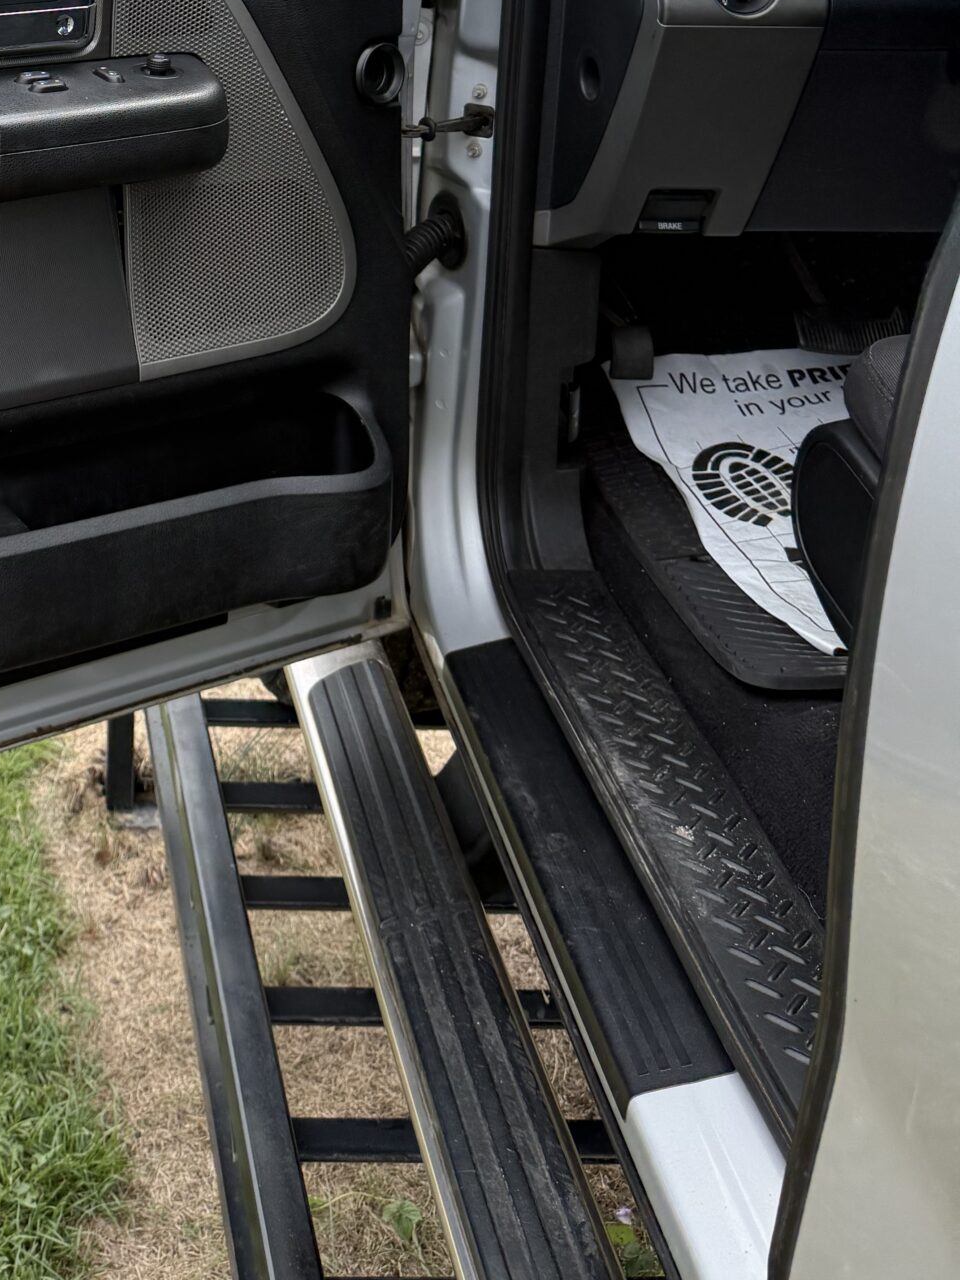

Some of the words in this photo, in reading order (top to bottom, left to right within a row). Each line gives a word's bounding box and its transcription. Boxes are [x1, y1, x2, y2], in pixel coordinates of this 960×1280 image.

[657, 222, 683, 231] BRAKE
[668, 371, 716, 394] We
[722, 370, 783, 393] take
[734, 399, 764, 417] in
[769, 390, 831, 415] your
